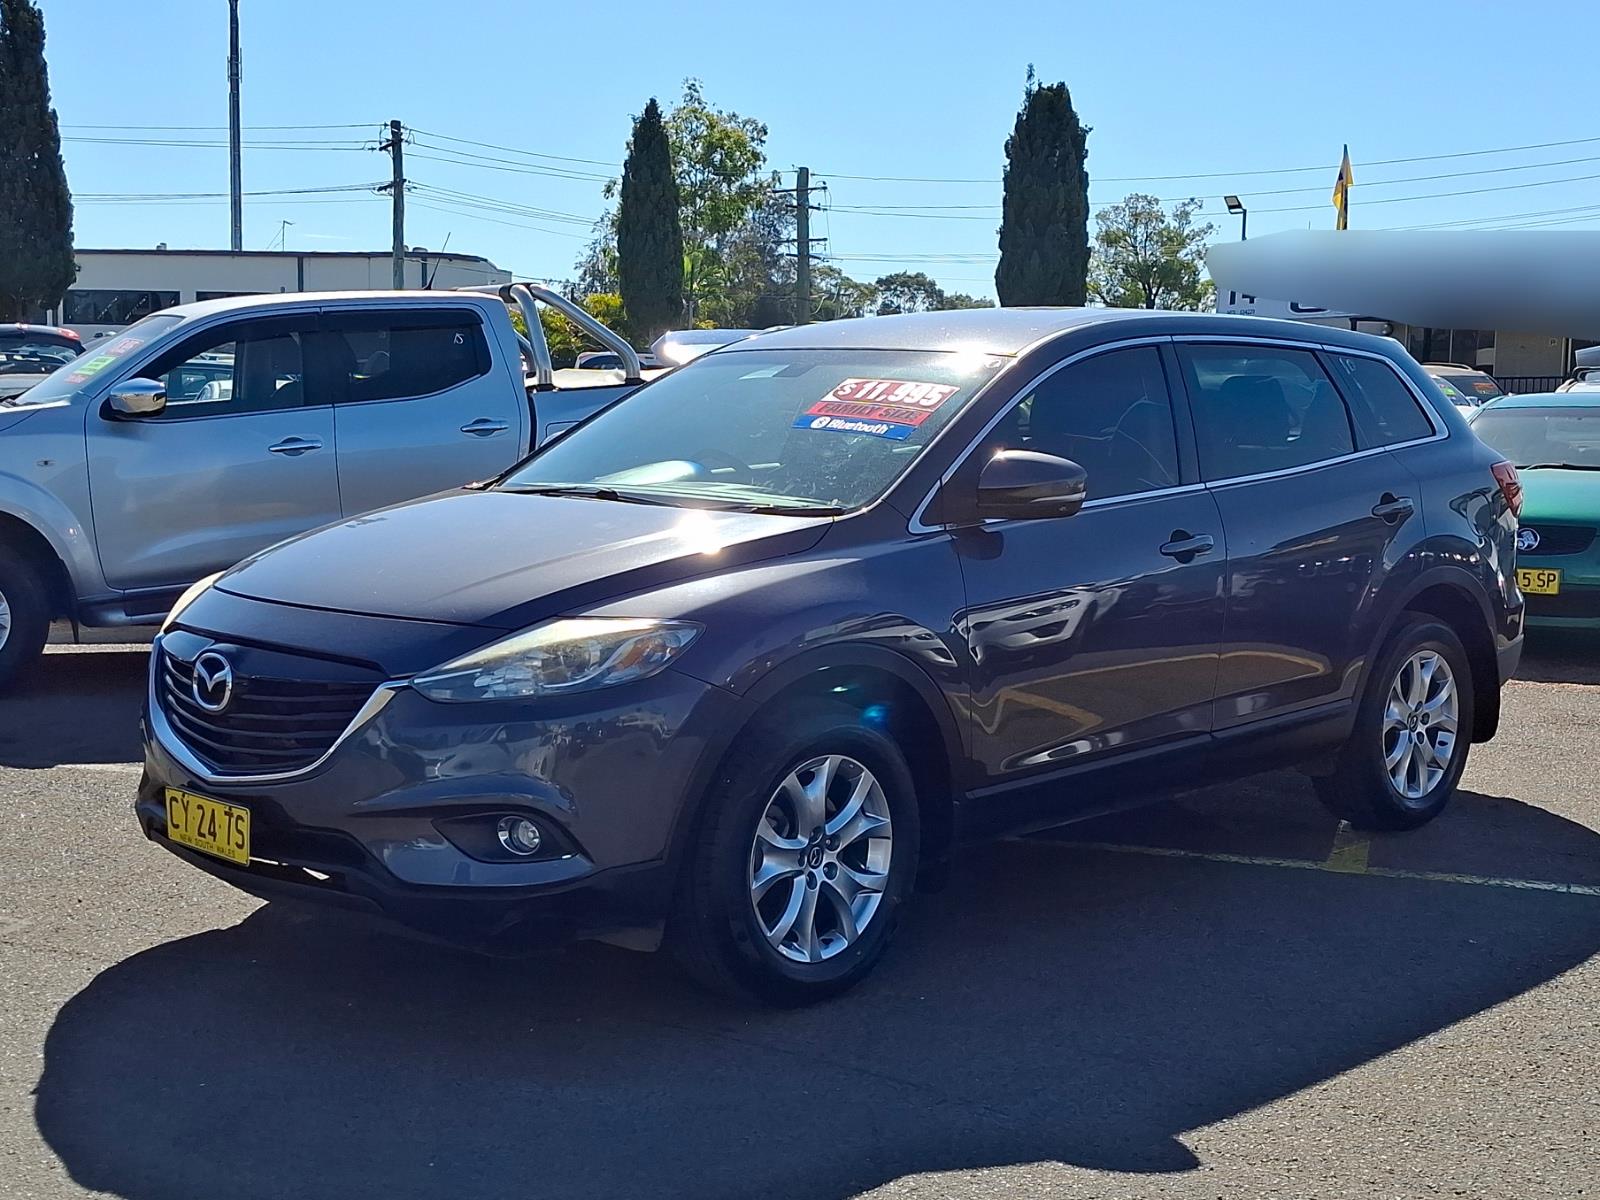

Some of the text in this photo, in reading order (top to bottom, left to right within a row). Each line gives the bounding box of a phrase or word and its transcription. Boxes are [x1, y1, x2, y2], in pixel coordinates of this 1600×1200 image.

[818, 402, 921, 421] FAMILY SIZE
[827, 418, 890, 434] Bluetooth
[1536, 572, 1557, 588] SP
[169, 796, 245, 849] CY 24 TS
